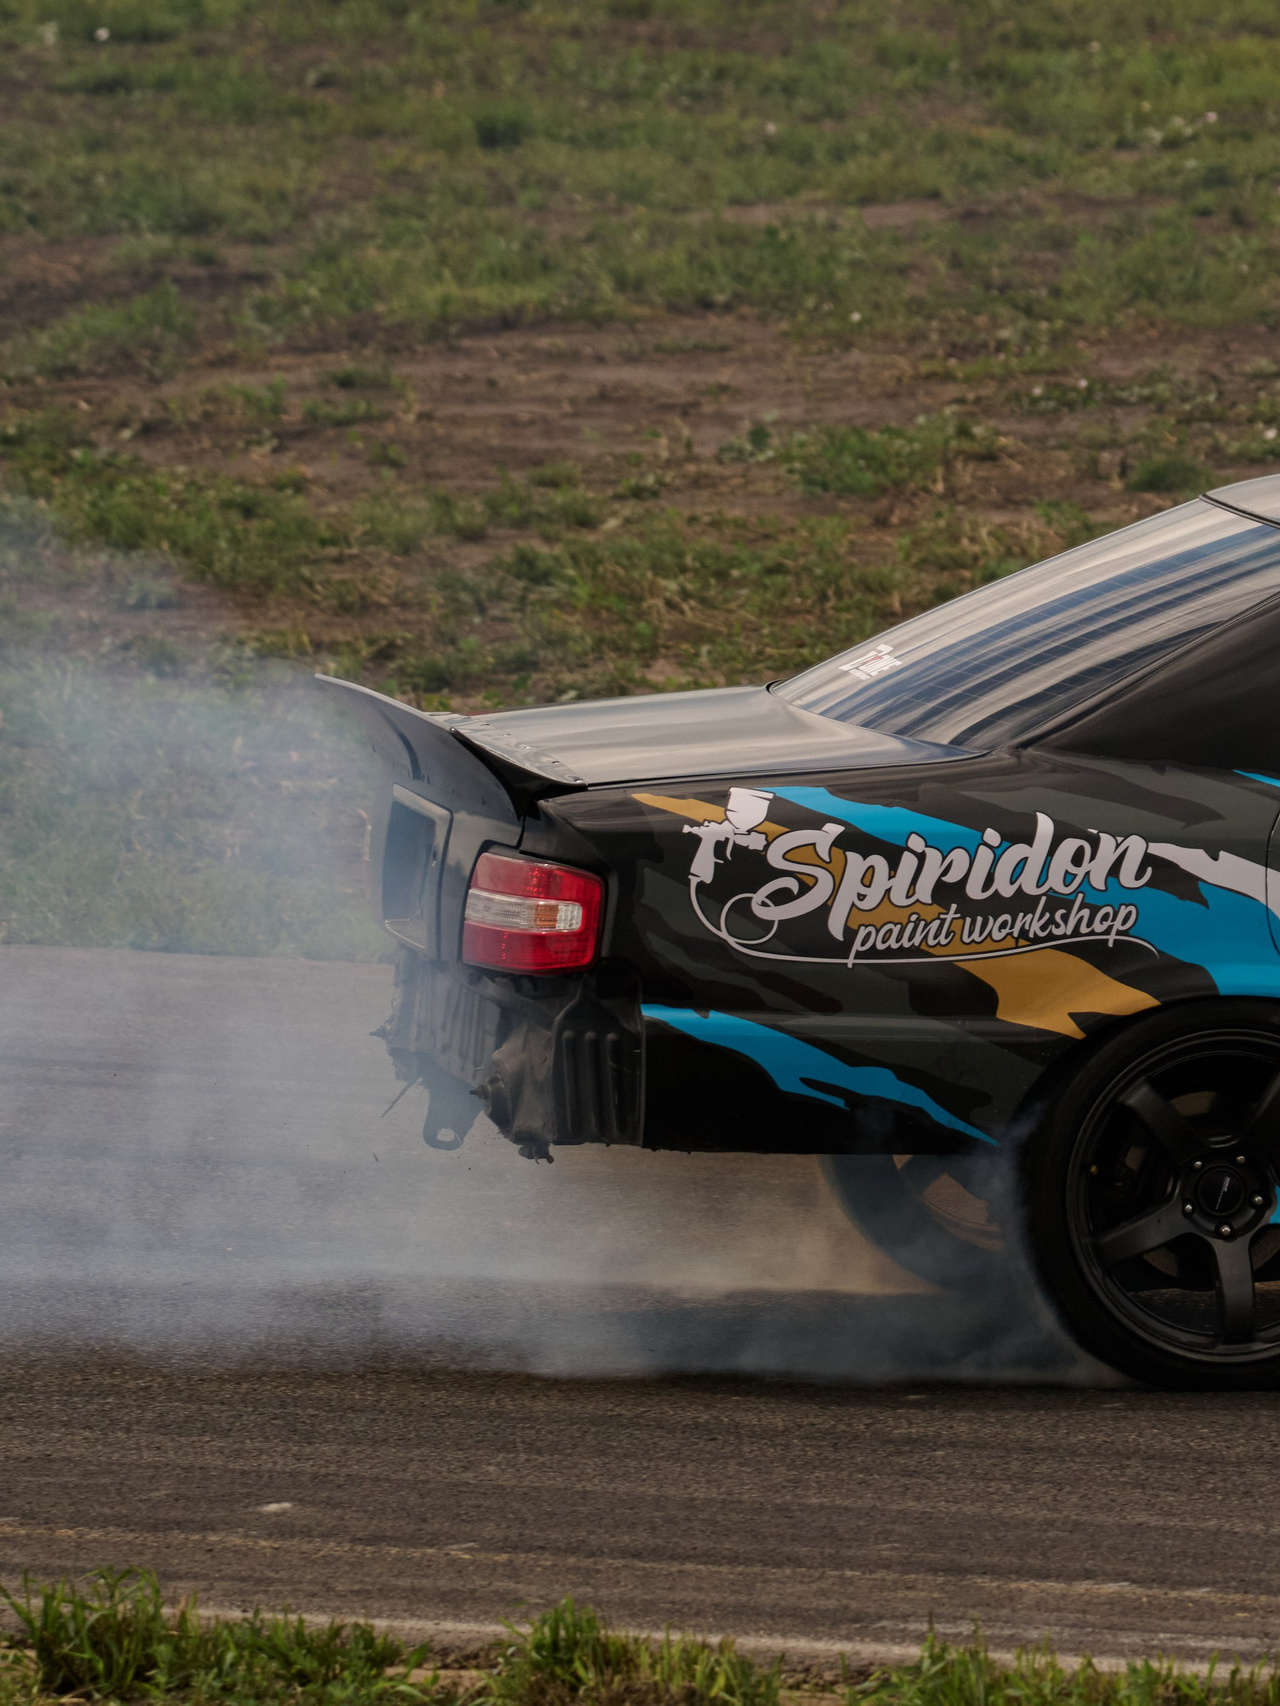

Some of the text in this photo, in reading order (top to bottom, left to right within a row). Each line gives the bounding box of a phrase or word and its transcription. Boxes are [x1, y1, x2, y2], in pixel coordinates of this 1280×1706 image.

[751, 811, 1152, 942] Spiridon
[847, 893, 1138, 968] paint workshop
